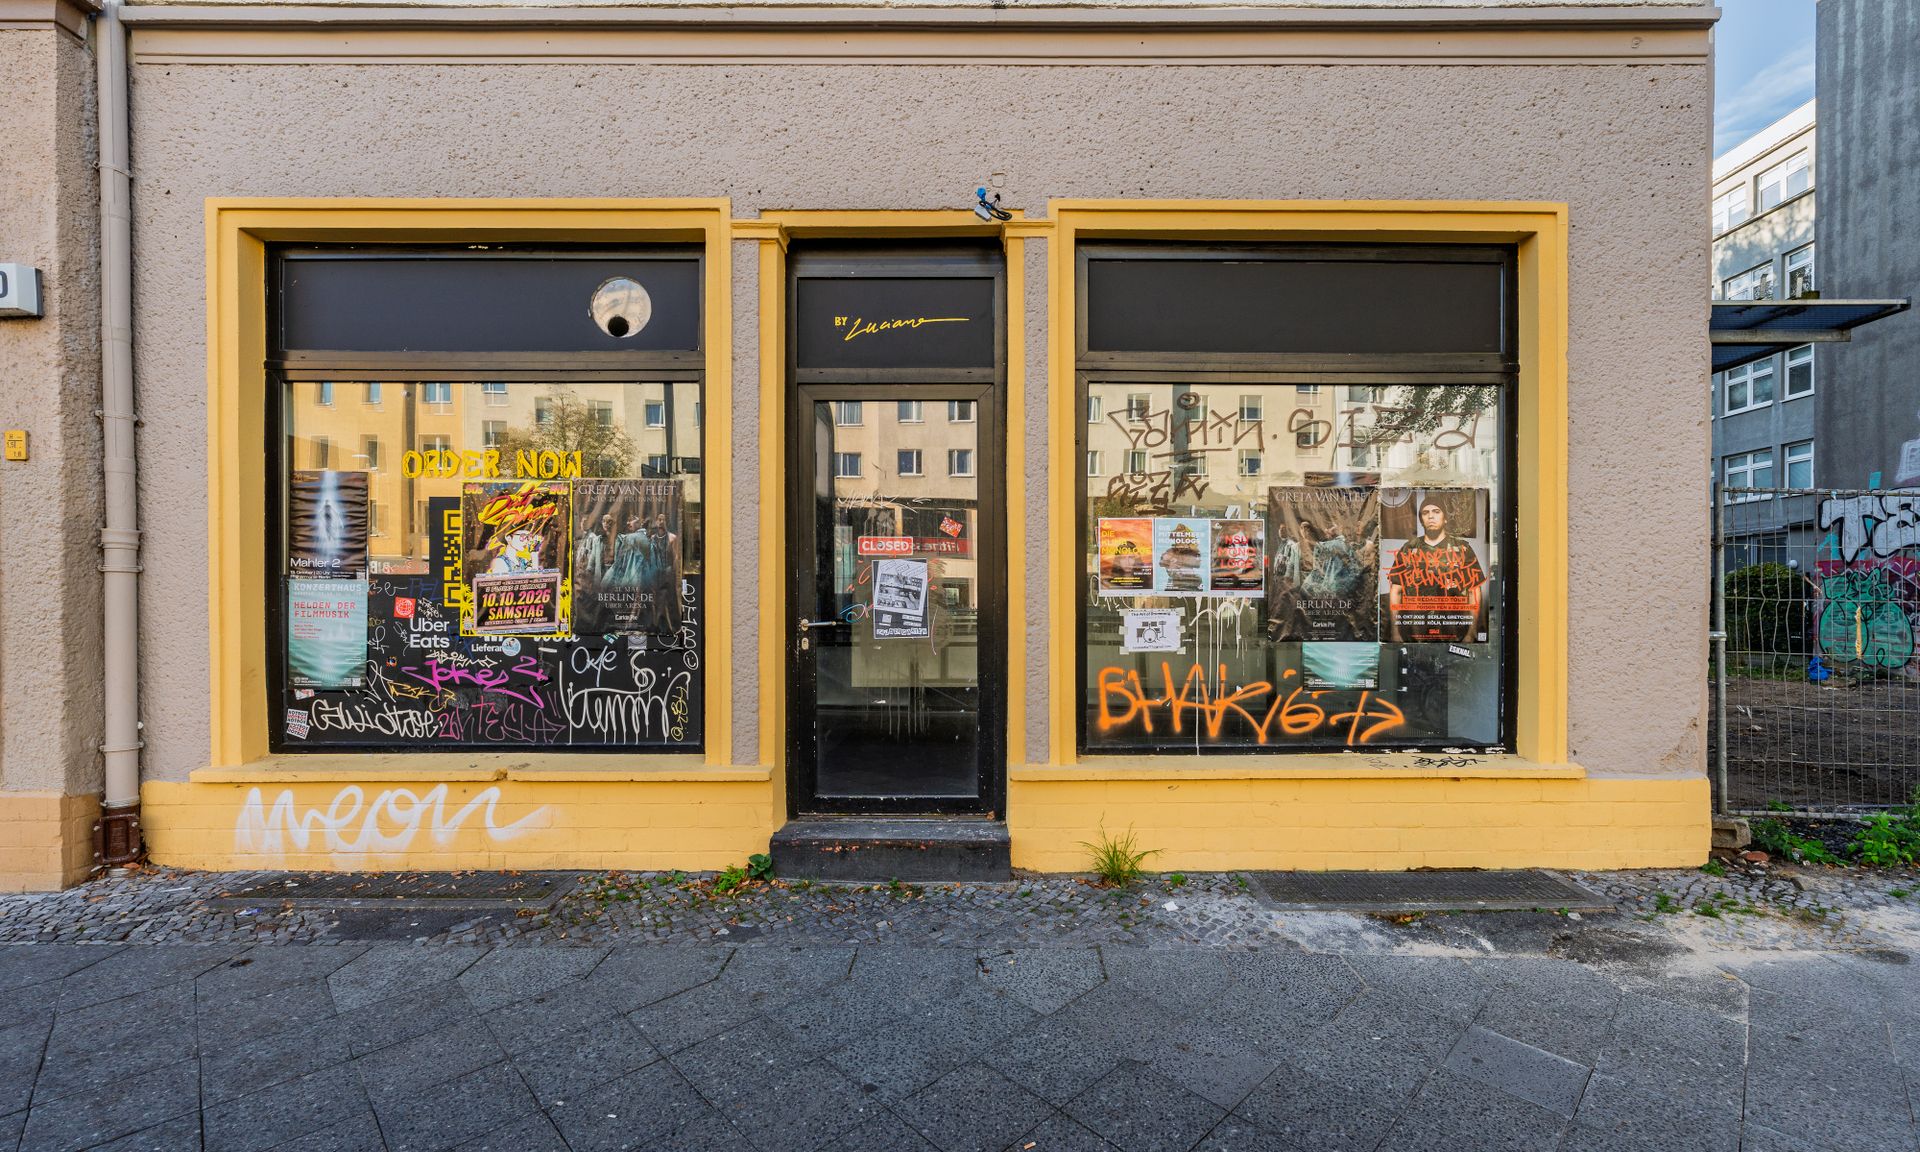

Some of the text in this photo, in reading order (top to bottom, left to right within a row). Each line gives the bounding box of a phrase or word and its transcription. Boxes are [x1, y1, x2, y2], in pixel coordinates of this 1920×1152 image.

[834, 316, 970, 341] BY Luciano
[402, 449, 582, 479] ORDER NOW
[578, 485, 677, 496] GRETA VAN FLEET
[1276, 492, 1312, 502] GRETA
[1316, 492, 1340, 502] VAN
[1101, 530, 1115, 538] DIE
[862, 541, 909, 552] CLOSED
[290, 557, 341, 568] Mahler 2
[294, 583, 362, 592] KONZERTHAUS
[482, 589, 552, 608] 10.10.2026
[597, 592, 655, 603] BERLIN, DE
[294, 601, 356, 610] HELDEN DER
[1296, 600, 1352, 609] BERLIN, DE
[294, 610, 350, 619] FILMMUSIK
[488, 604, 544, 620] SAMSTAG
[410, 618, 450, 632] Uber
[410, 634, 450, 648] Eats
